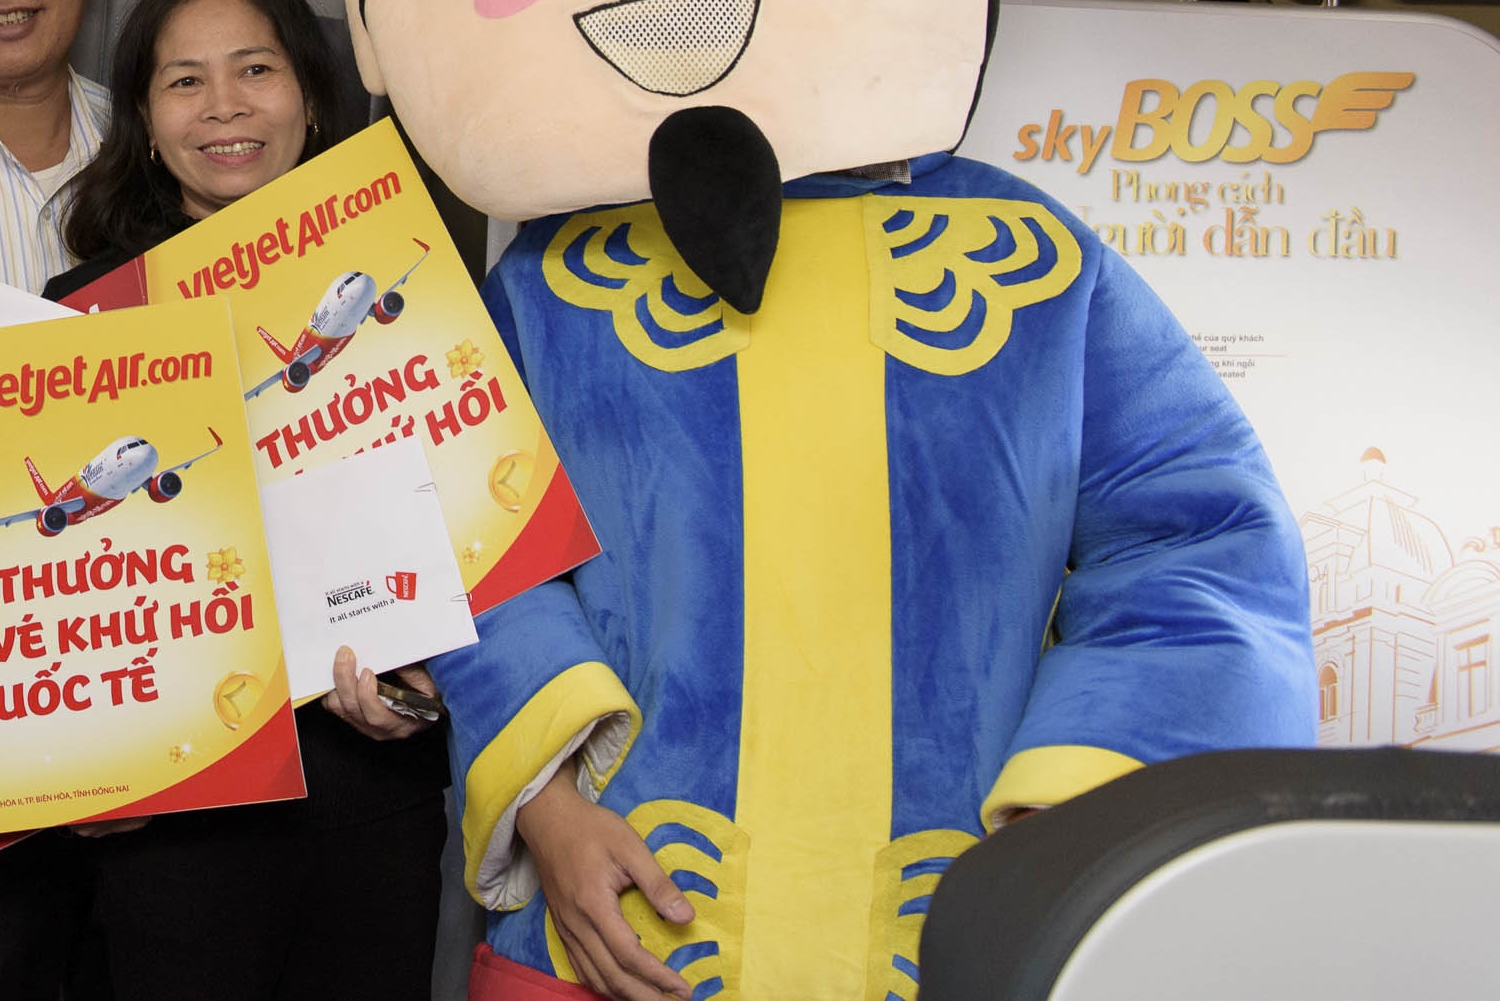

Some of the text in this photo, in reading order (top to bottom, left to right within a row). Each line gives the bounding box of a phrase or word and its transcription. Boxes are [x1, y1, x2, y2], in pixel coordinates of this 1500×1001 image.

[1109, 169, 1286, 213] Phong cách
[1203, 205, 1290, 258] dẫn
[1307, 207, 1397, 259] đầu
[255, 354, 440, 469] THƯỞNG
[424, 370, 508, 446] HỒI
[57, 595, 158, 655] KHỨ
[170, 581, 255, 634] HỒI
[327, 580, 373, 608] NESCAFÉ
[329, 616, 336, 624] It
[337, 612, 348, 622] all
[349, 606, 371, 618] starts
[372, 599, 389, 610] with
[100, 647, 159, 706] TẾ
[0, 799, 17, 808] HÒA
[91, 786, 115, 797] ĐỒNG
[115, 784, 130, 793] NAI
